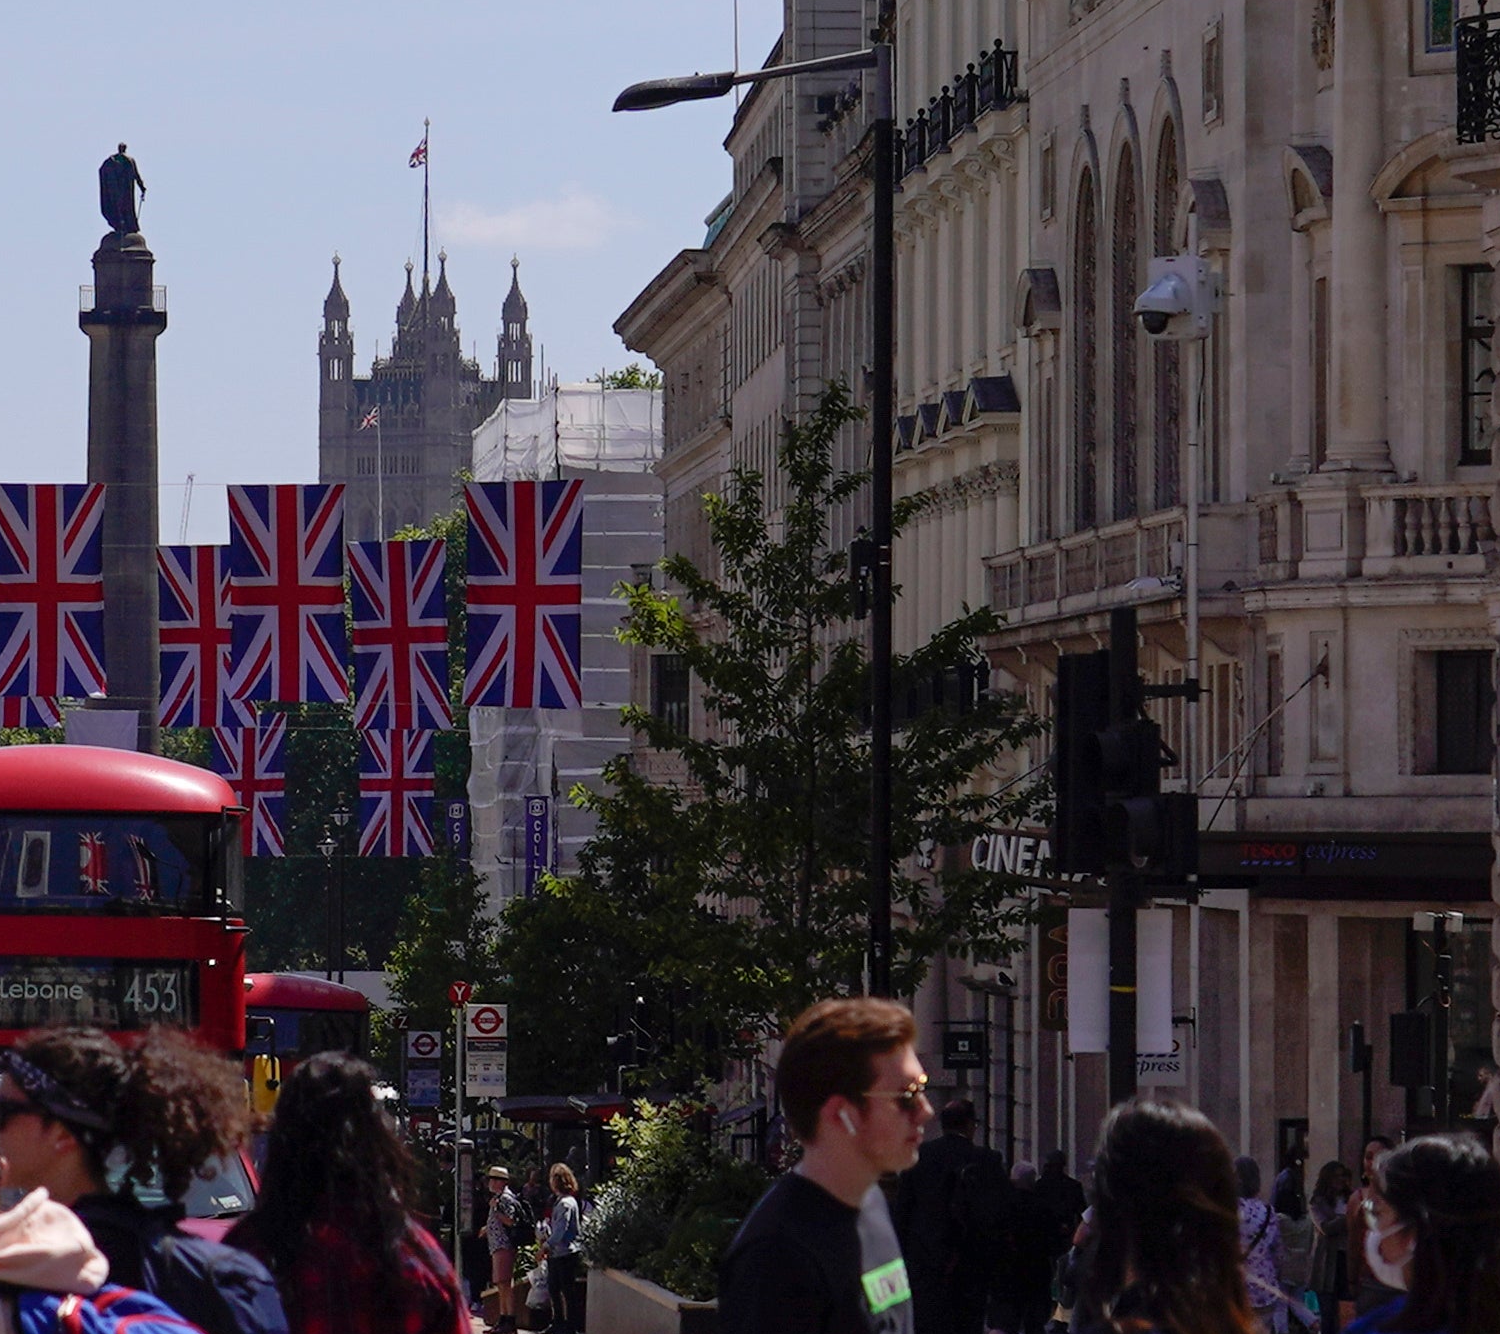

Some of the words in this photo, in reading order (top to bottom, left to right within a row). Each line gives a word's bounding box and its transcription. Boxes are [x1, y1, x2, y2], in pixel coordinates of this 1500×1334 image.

[1242, 842, 1298, 860] TESCO
[1305, 840, 1378, 864] express
[123, 970, 178, 1013] 453
[453, 985, 467, 1001] Y
